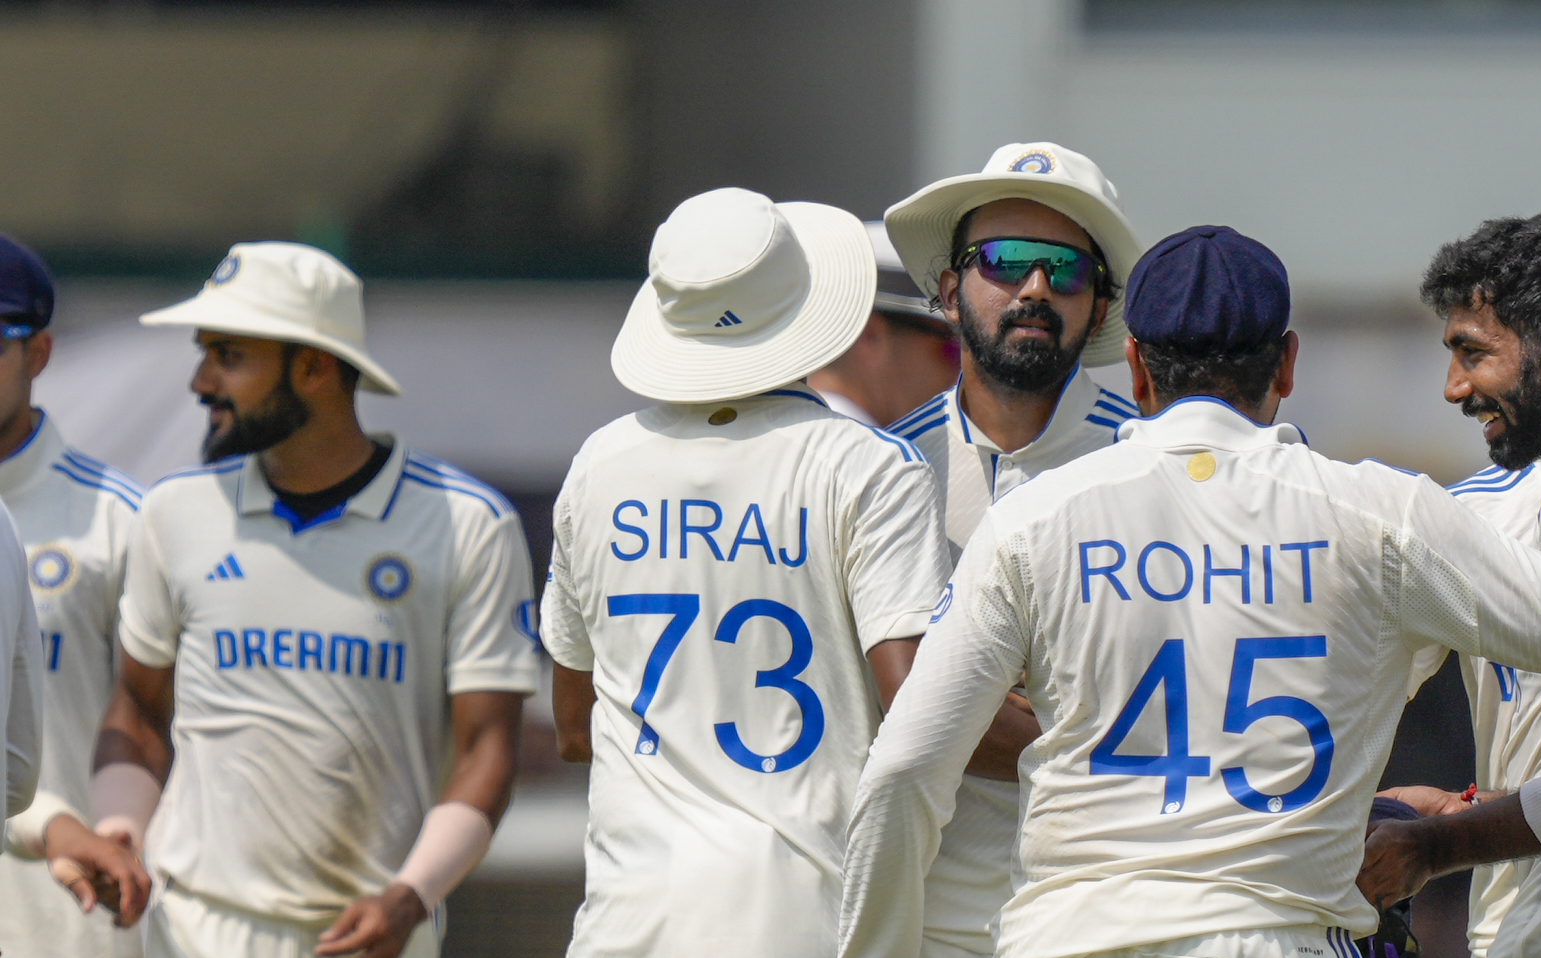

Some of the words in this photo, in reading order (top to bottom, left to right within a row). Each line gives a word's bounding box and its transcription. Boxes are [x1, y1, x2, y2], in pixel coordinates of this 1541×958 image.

[610, 499, 808, 568] SIRAJ
[1079, 539, 1330, 605] ROHIT
[213, 628, 406, 684] DREAM11
[606, 593, 827, 775] 73
[1089, 635, 1336, 815] 45
